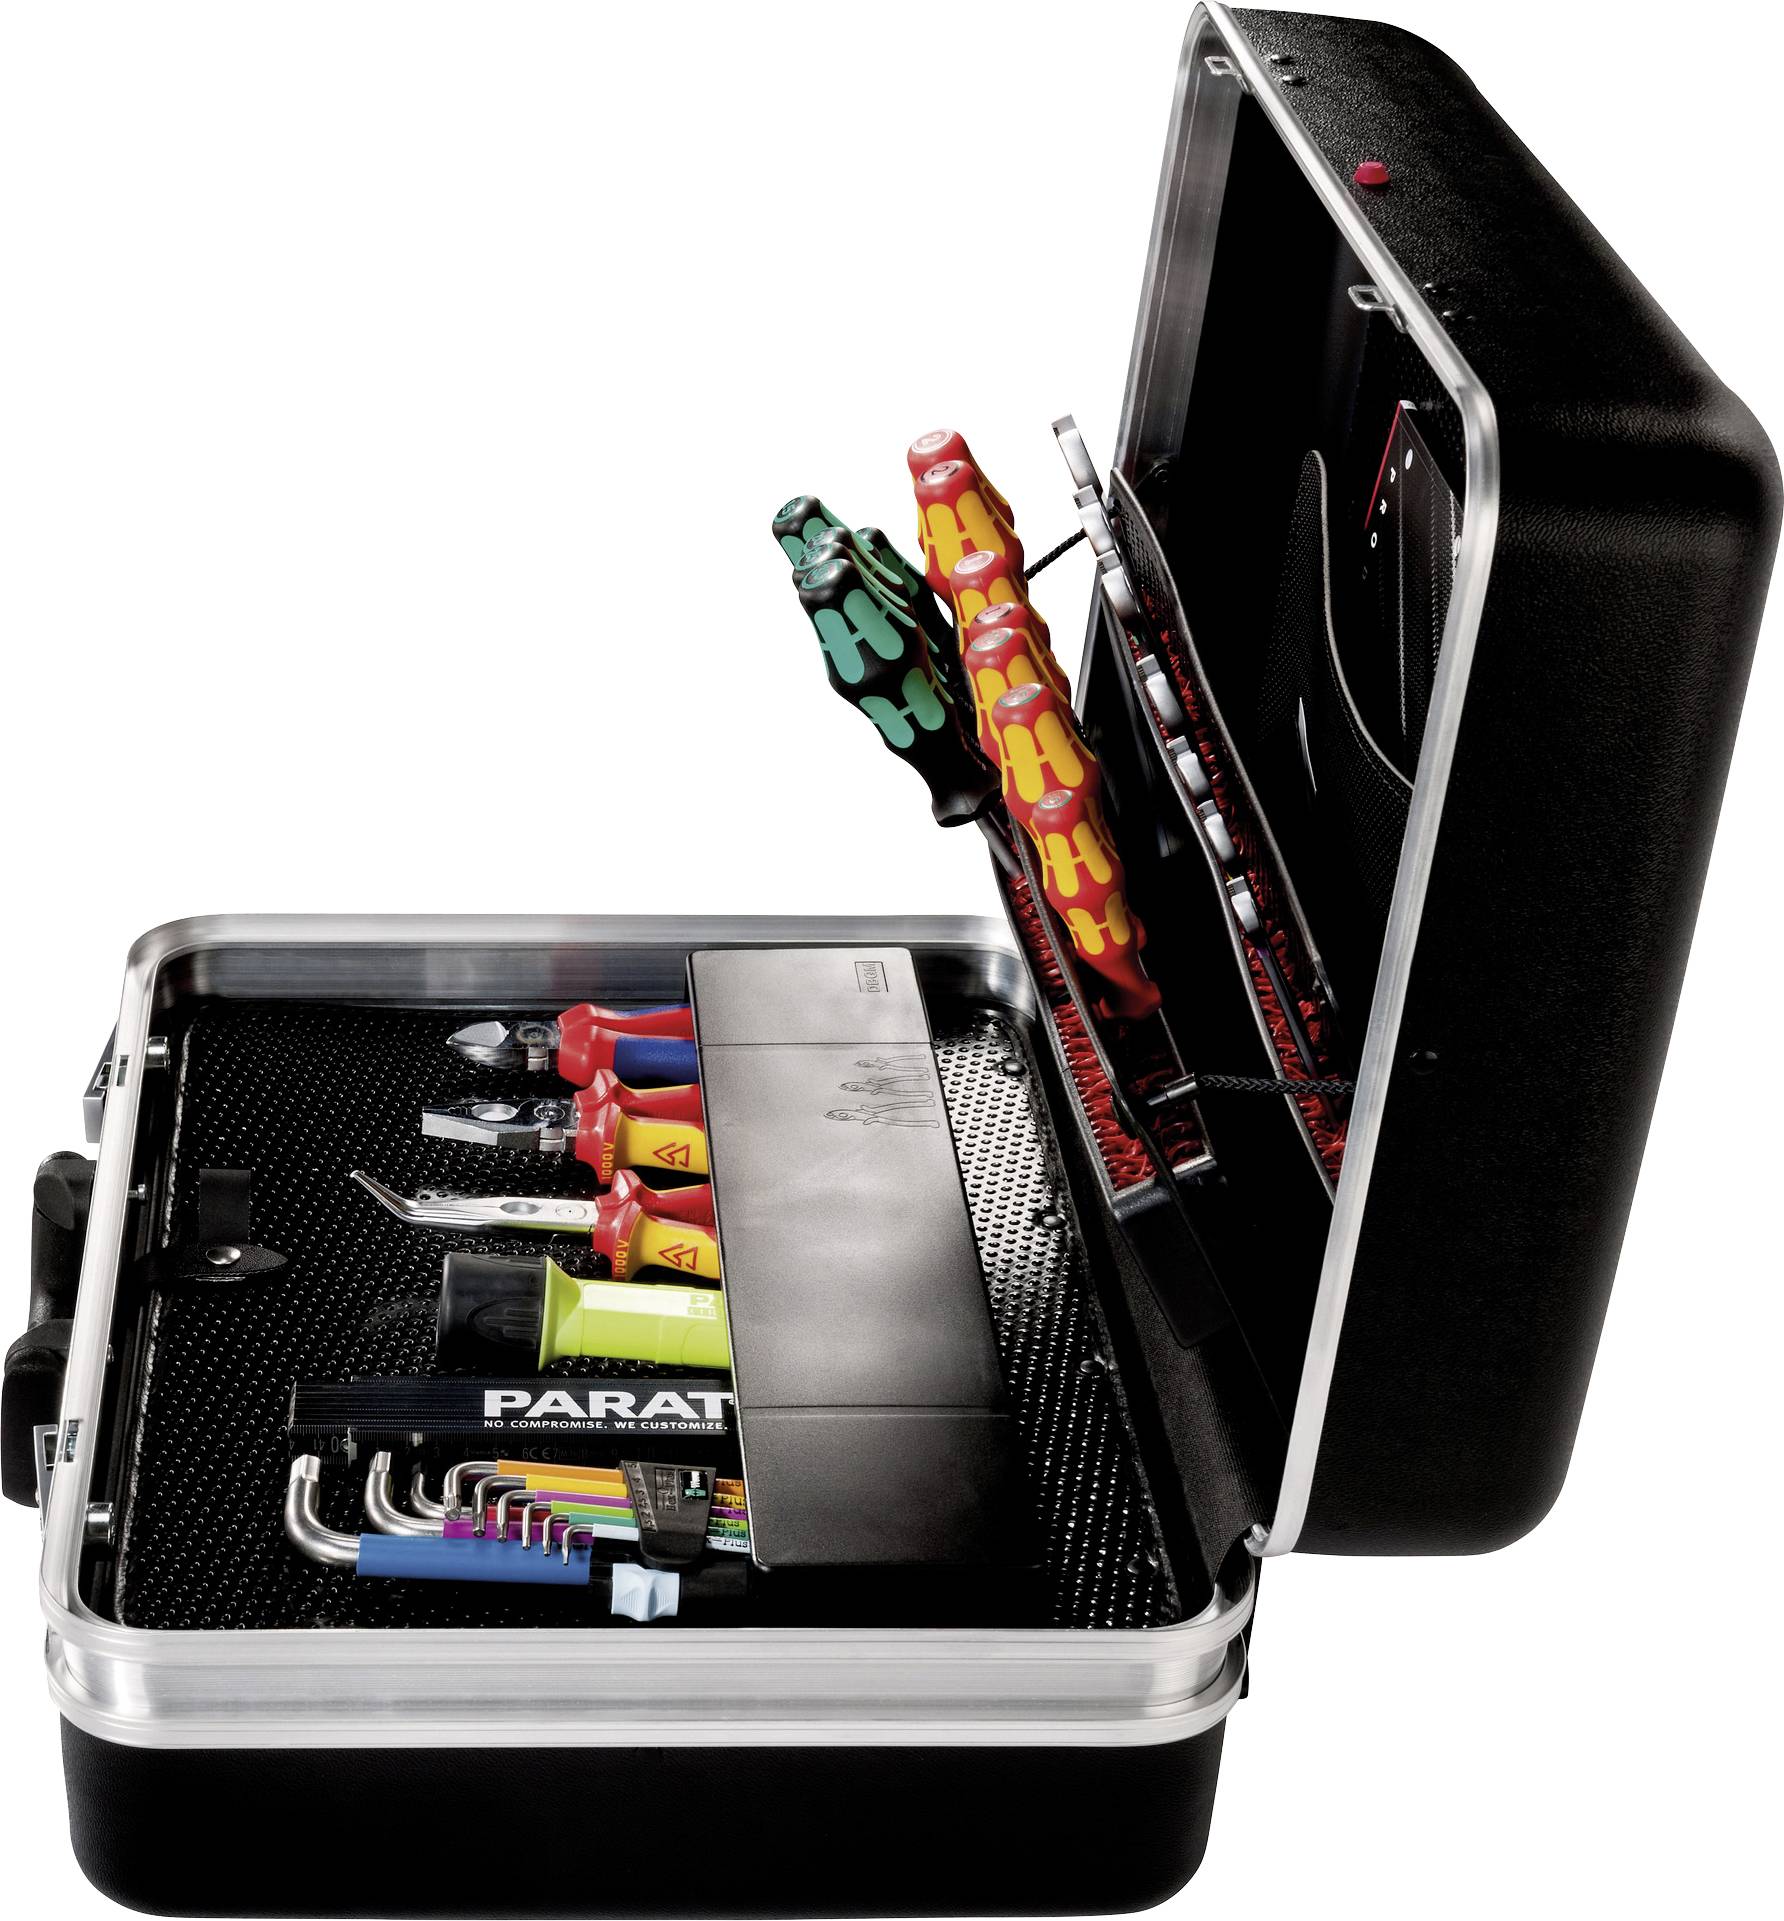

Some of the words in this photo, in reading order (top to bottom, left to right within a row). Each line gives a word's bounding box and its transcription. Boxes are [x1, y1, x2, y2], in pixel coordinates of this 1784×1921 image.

[484, 1389, 734, 1419] PARAT
[484, 1420, 504, 1428] NO
[510, 1420, 608, 1429] COMPROMISE.
[614, 1421, 636, 1429] WE
[640, 1421, 728, 1430] CUSTOMIZE.
